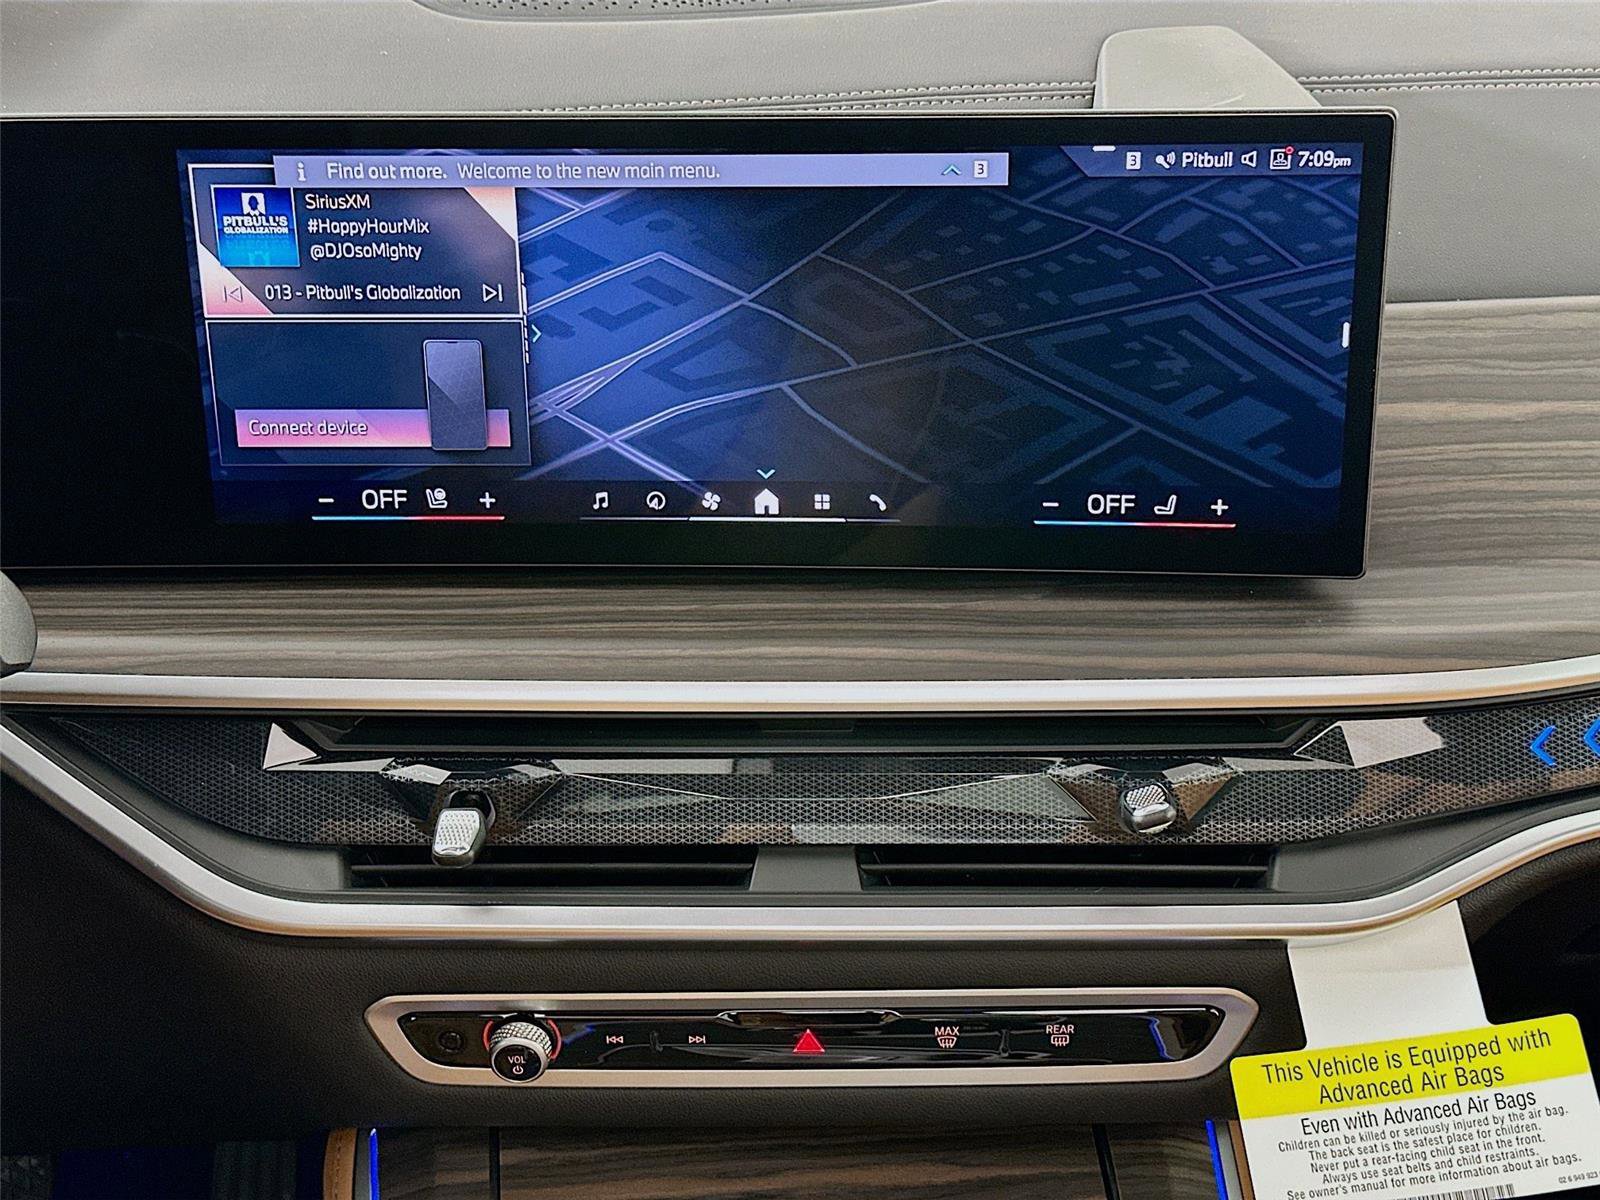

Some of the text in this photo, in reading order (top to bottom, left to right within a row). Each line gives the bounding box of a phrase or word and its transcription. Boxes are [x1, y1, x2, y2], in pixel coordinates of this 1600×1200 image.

[1182, 151, 1233, 168] Pitbull
[327, 162, 364, 180] Find
[368, 164, 396, 180] out
[400, 164, 448, 180] more.
[457, 162, 531, 180] Welcome
[536, 163, 552, 179] to
[556, 162, 582, 179] the
[586, 164, 621, 179] new
[624, 162, 665, 179] main
[669, 164, 720, 180] menu.
[305, 193, 370, 209] SiriusXM
[222, 215, 288, 227] PITBULL'S
[223, 226, 289, 234] GLOBALIZATION
[307, 218, 430, 236] #HappyHourMix
[310, 242, 422, 261] @DJOsoMighty
[265, 284, 292, 300] 013
[306, 284, 363, 300] Pitbull's
[366, 284, 461, 300] Globalization
[248, 420, 368, 436] Connect device
[361, 489, 408, 509] OFF
[1087, 494, 1136, 514] OFF
[934, 1026, 960, 1036] MAX
[1045, 1024, 1075, 1034] REAR
[508, 1055, 526, 1064] VOL
[1261, 1028, 1552, 1084] This Vehicle is Equipped with
[1319, 1065, 1505, 1105] Advanced Air Bags
[1301, 1091, 1537, 1136] Even with Advanced Air Bags
[1278, 1104, 1569, 1153] Children can be killed or seriously injured by the air bag.
[1308, 1121, 1542, 1161] The back seat is the safest place for children.
[1310, 1160, 1341, 1173] Never
[1342, 1158, 1361, 1171] put
[1362, 1158, 1369, 1167] a
[1430, 1146, 1456, 1159] child
[1458, 1142, 1480, 1155] seat
[1482, 1139, 1494, 1150] in
[1495, 1137, 1514, 1149] the
[1515, 1132, 1546, 1146] front.
[1322, 1147, 1540, 1184] Always use seat belts and child restraints.
[1287, 1152, 1582, 1200] See owner's manual for more information about air bags.
